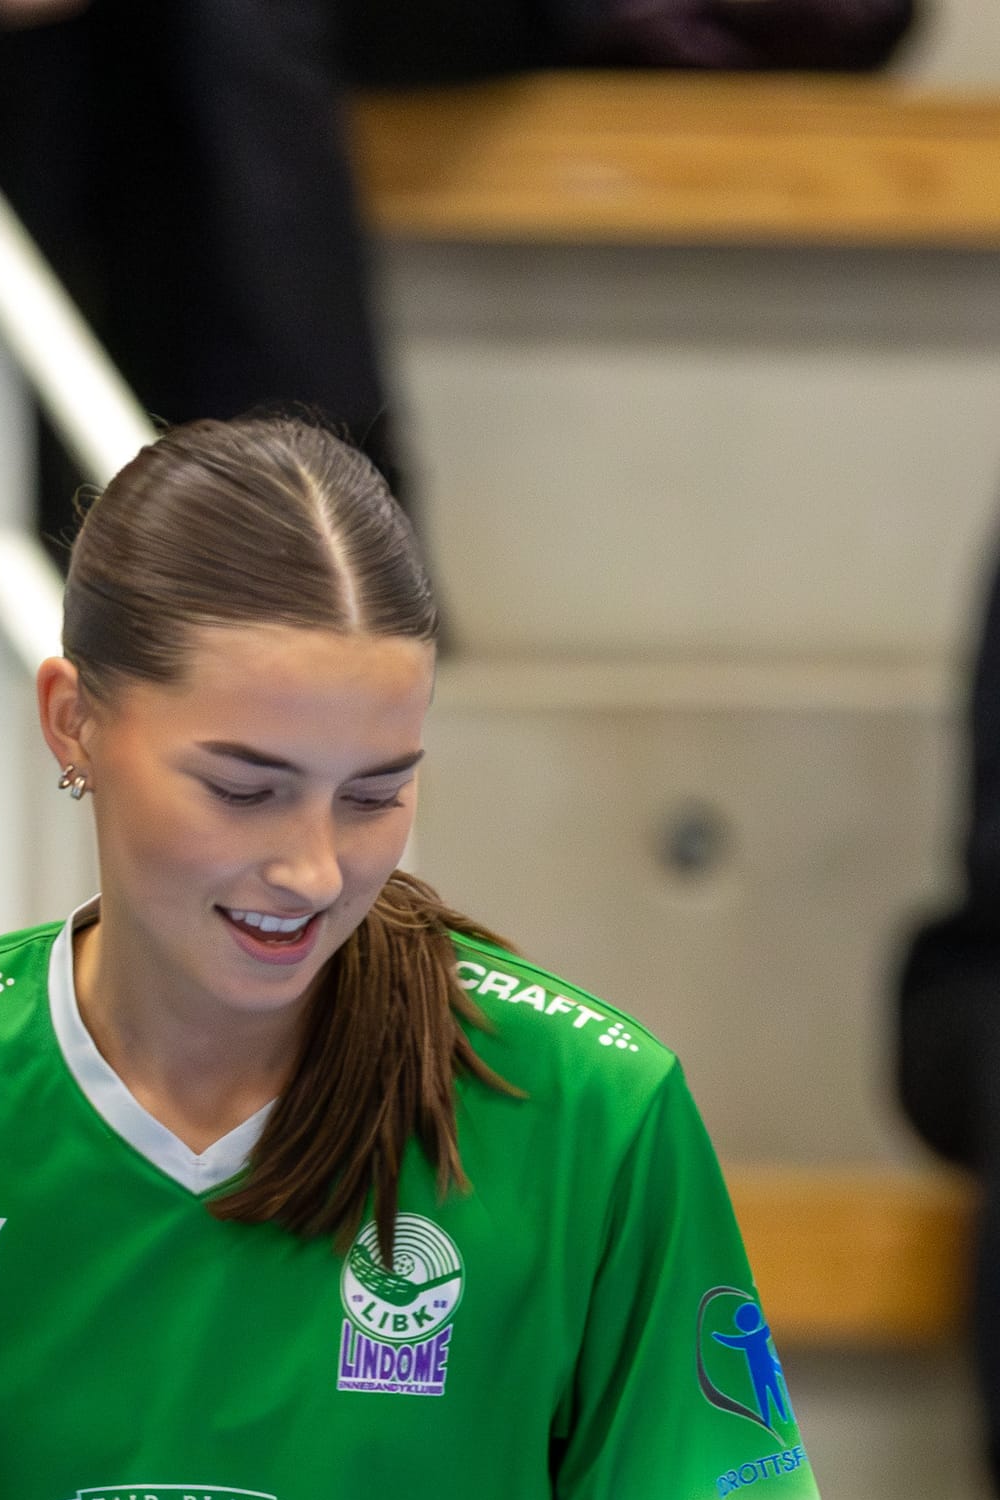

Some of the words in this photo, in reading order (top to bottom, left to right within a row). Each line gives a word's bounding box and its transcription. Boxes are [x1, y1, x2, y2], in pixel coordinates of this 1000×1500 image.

[455, 960, 606, 1029] CRAFT
[361, 1301, 435, 1332] LIBK
[339, 1318, 454, 1384] LINDOME
